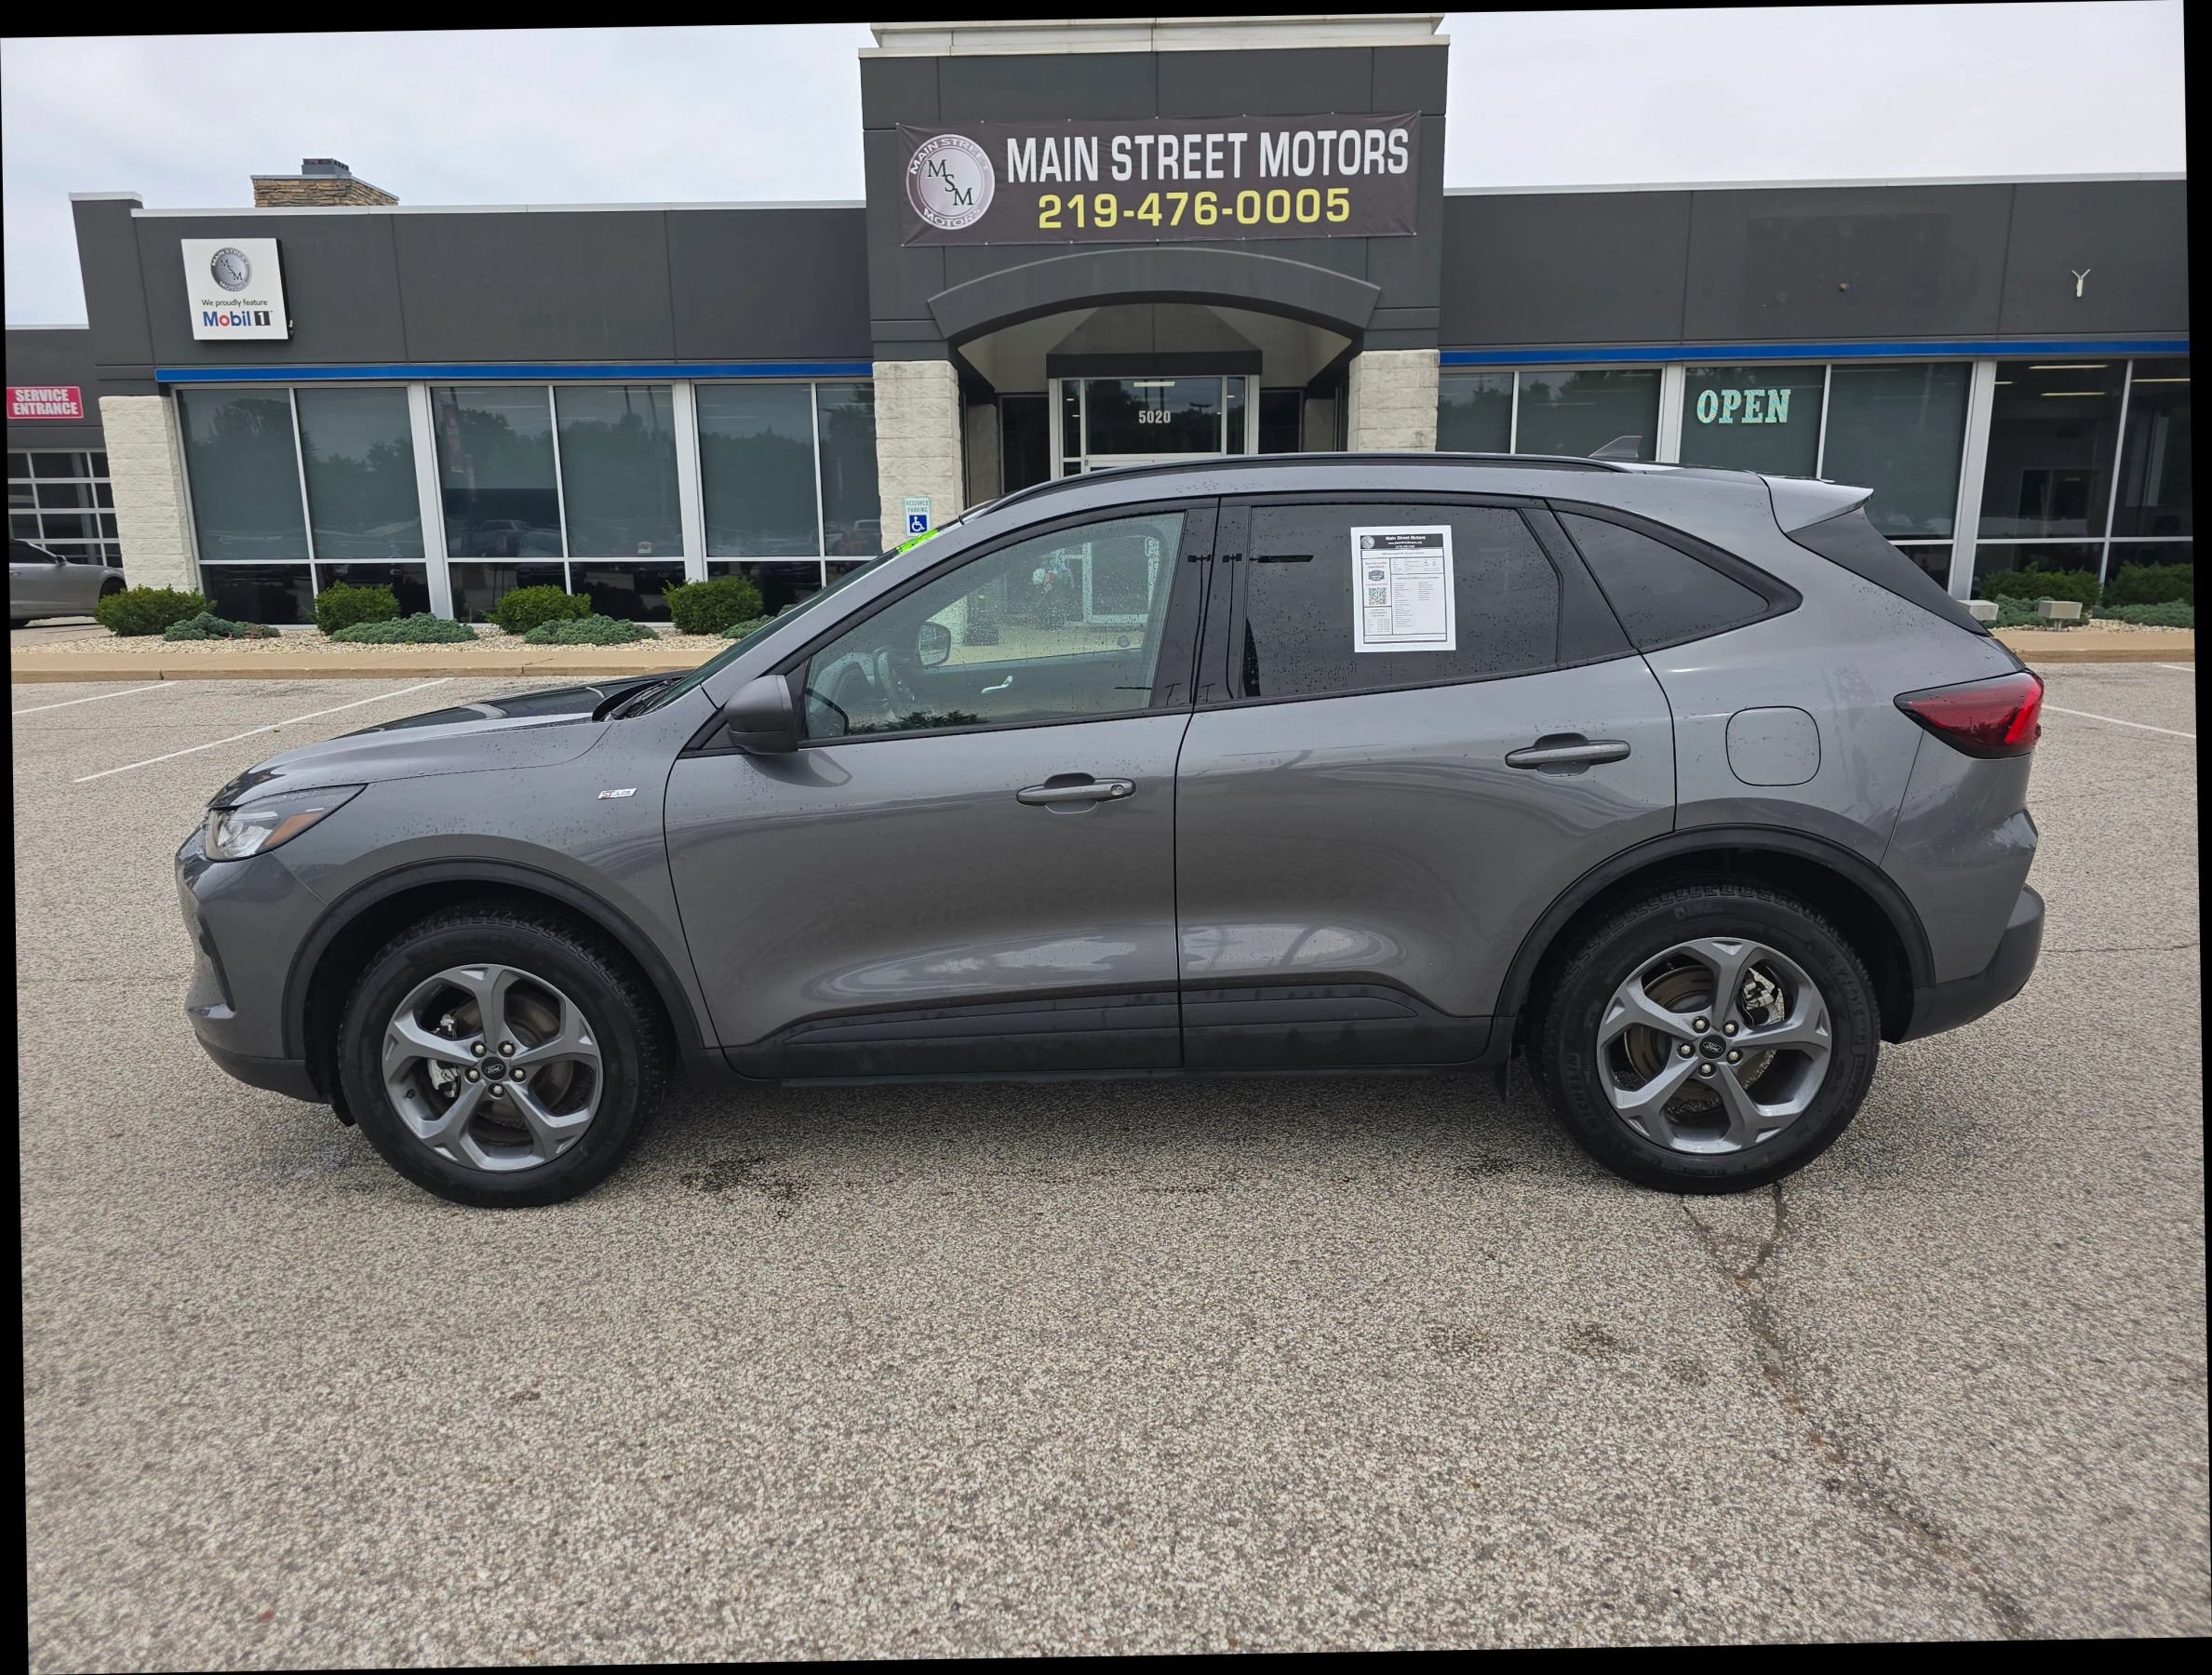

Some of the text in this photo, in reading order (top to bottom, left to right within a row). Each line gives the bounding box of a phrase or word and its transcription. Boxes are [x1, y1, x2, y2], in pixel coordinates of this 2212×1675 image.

[910, 141, 940, 175] MAIN
[1006, 128, 1410, 183] MAIN STREET MOTORS
[923, 208, 981, 227] MOTORS
[1039, 188, 1350, 230] 219-476-0005
[215, 299, 241, 307] proudly
[202, 310, 251, 327] Mobil
[15, 389, 70, 402] SERVICE
[12, 402, 79, 415] ENTRANCE
[1696, 388, 1791, 423] OPEN
[1138, 409, 1172, 423] 5020
